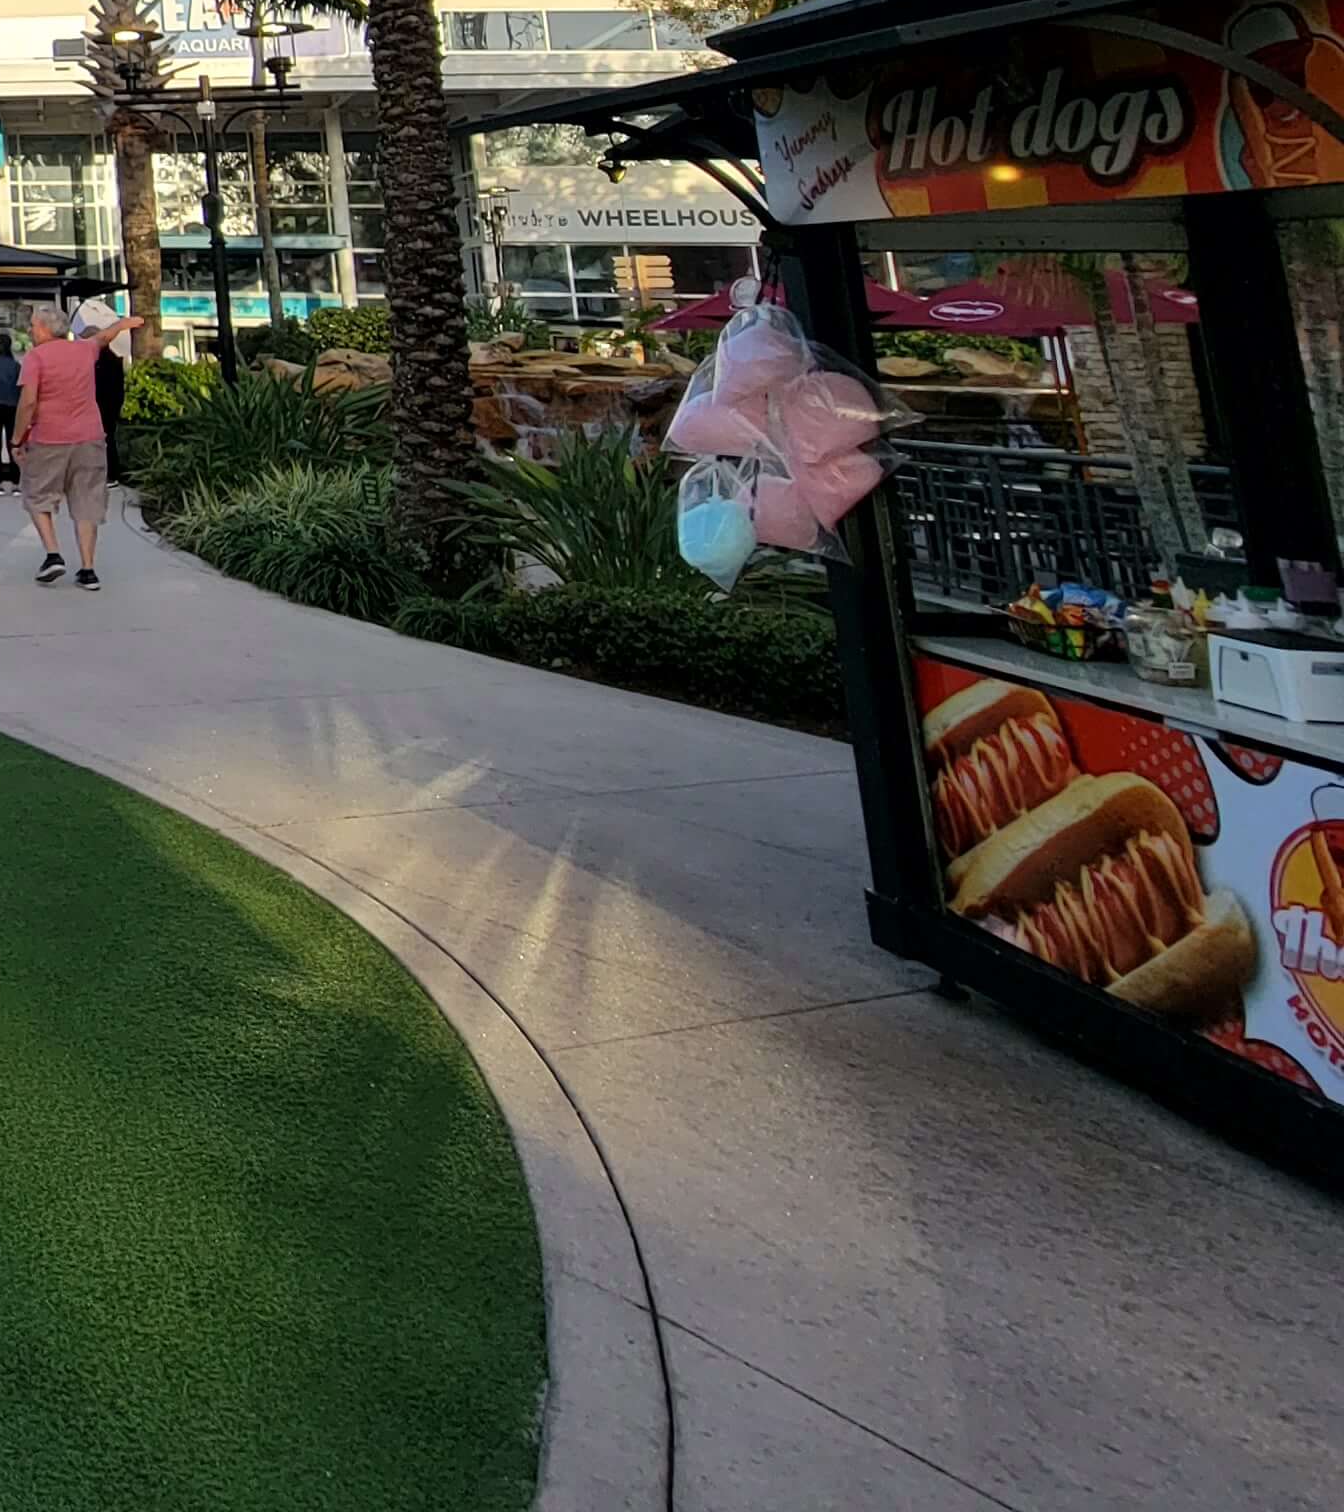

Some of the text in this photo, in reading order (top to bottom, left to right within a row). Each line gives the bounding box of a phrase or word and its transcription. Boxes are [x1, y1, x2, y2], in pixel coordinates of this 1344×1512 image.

[883, 67, 1184, 176] Hot dogs
[577, 209, 758, 227] WHEELHOUS
